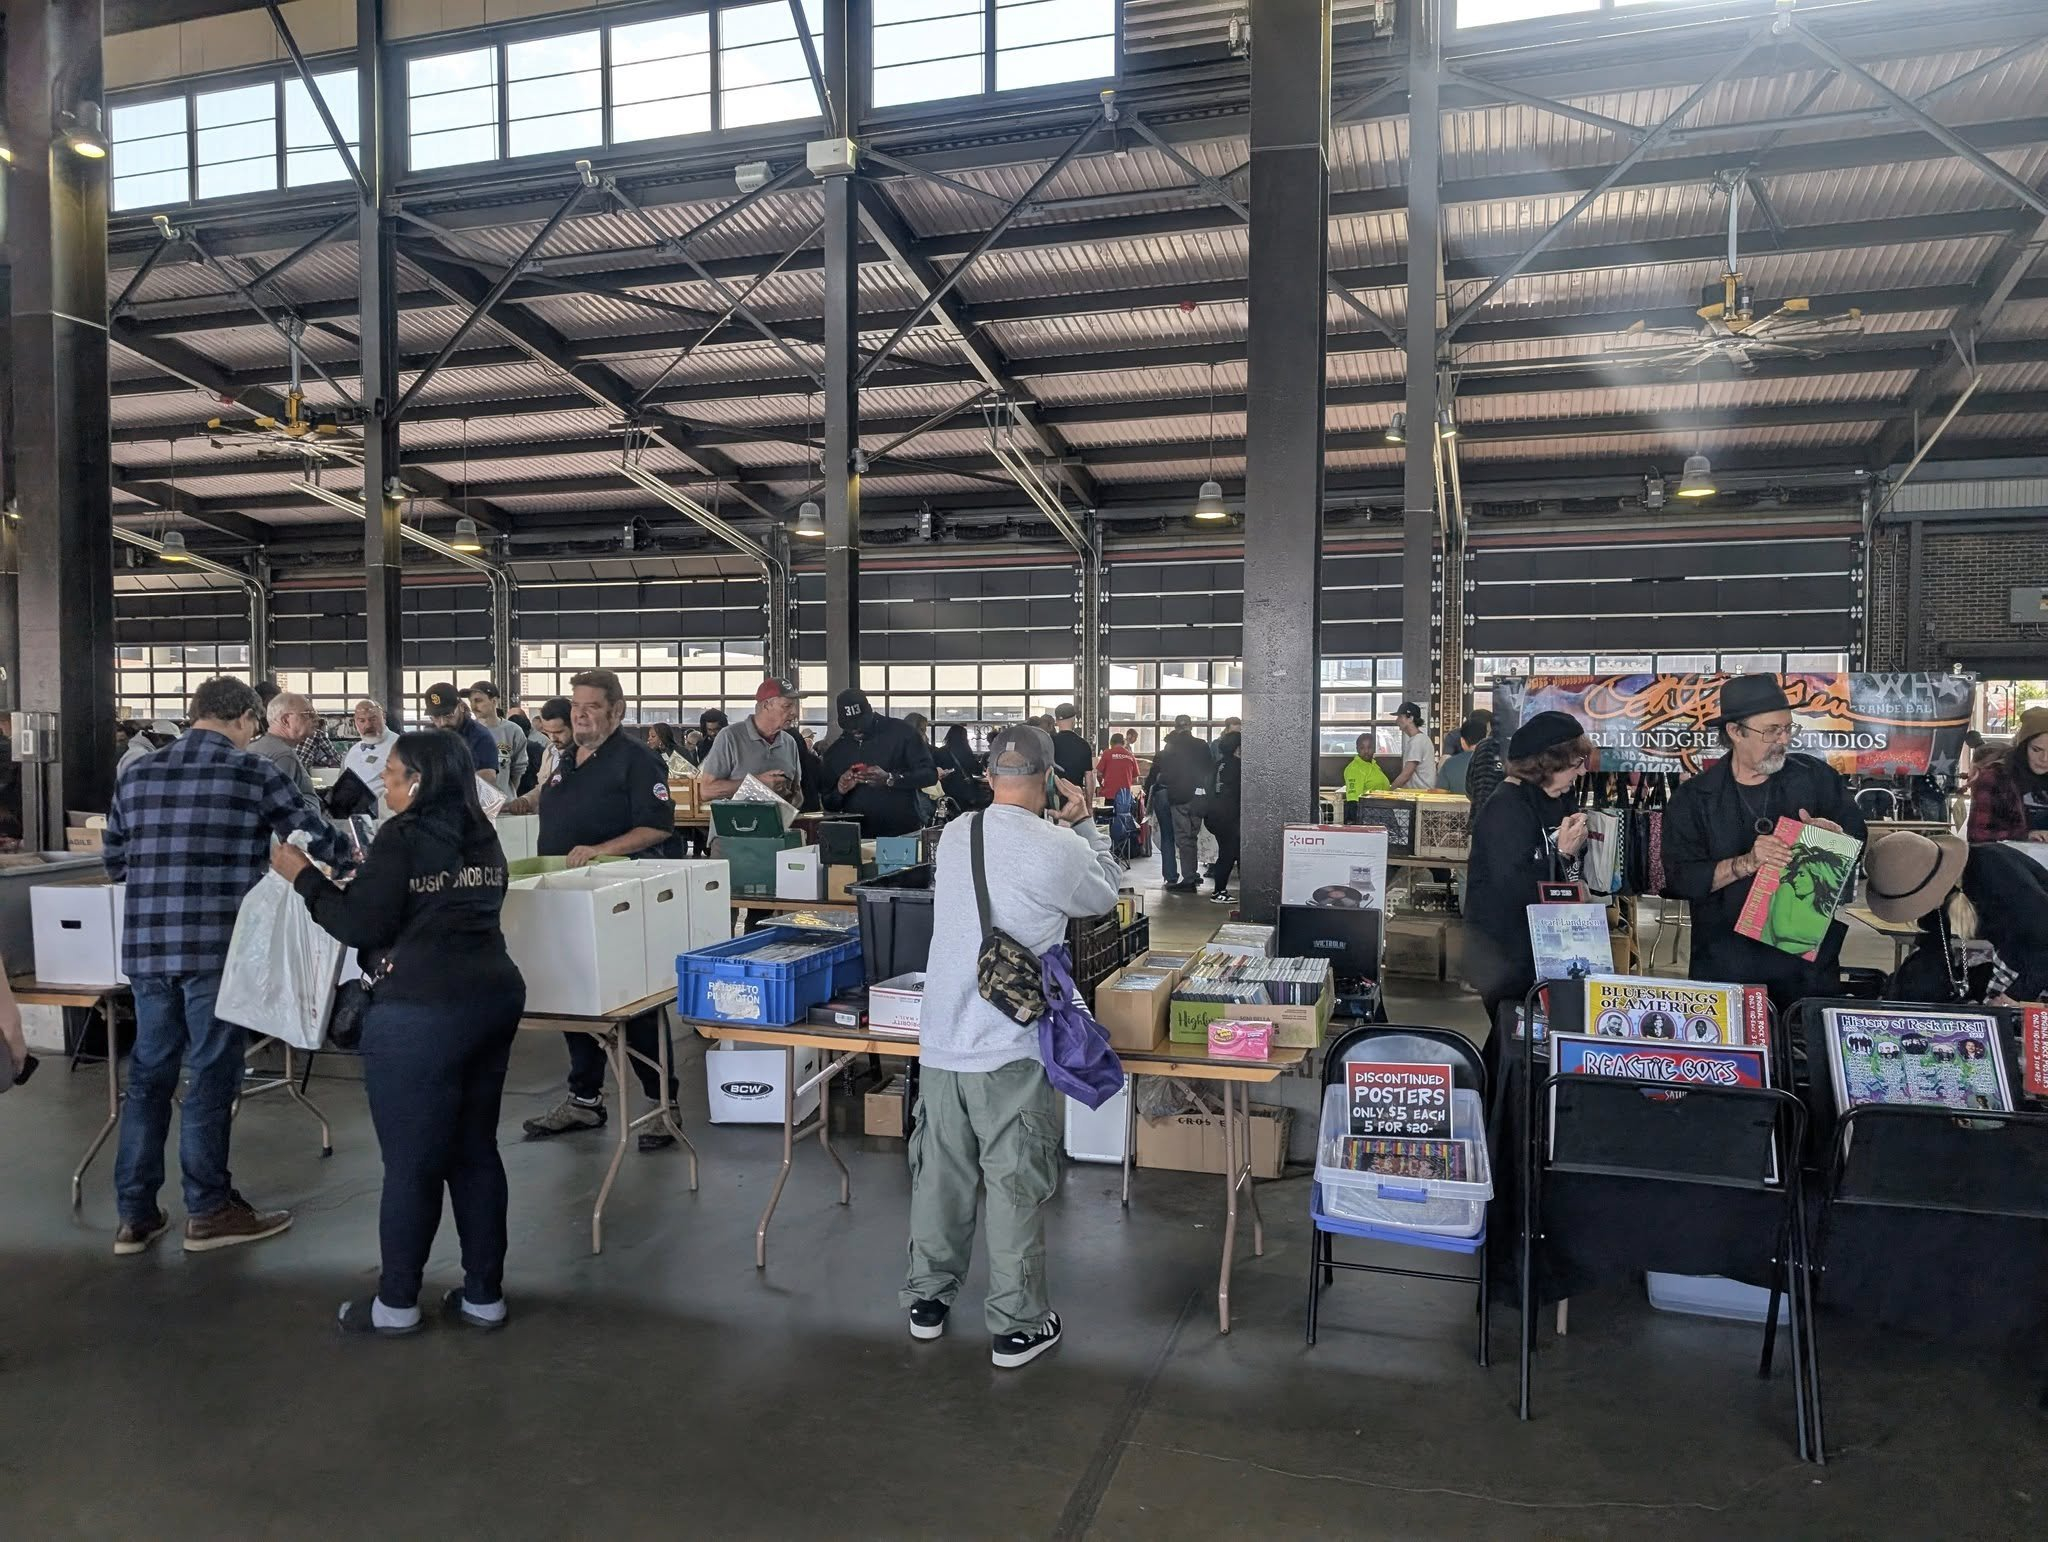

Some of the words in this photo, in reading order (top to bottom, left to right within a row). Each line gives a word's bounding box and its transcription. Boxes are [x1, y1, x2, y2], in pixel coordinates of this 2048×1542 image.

[844, 704, 861, 716] 313
[1589, 732, 1613, 747] RL
[1619, 732, 1719, 748] LUNDGRE
[1791, 732, 1887, 749] STUDIOS
[1601, 986, 1656, 1000] BLUES
[1661, 990, 1718, 1004] KINGS
[1601, 998, 1616, 1008] of
[1623, 999, 1718, 1015] AMERICA
[1842, 1016, 1888, 1030] History
[1892, 1019, 1905, 1029] of
[1907, 1020, 1940, 1031] Rock
[1957, 1021, 1985, 1033] Roll
[1584, 1051, 1677, 1080] BEASTIE
[1682, 1060, 1737, 1083] BOYS
[1355, 1072, 1444, 1085] DISCONTINUED
[730, 1084, 763, 1094] BCW
[1354, 1086, 1445, 1106] POSTERS
[1353, 1107, 1384, 1118] ONLY
[1388, 1105, 1407, 1121] $5
[1413, 1109, 1446, 1121] EACH
[1178, 1117, 1226, 1127] CROSE
[1364, 1121, 1373, 1132] 5
[1378, 1121, 1402, 1133] FOR
